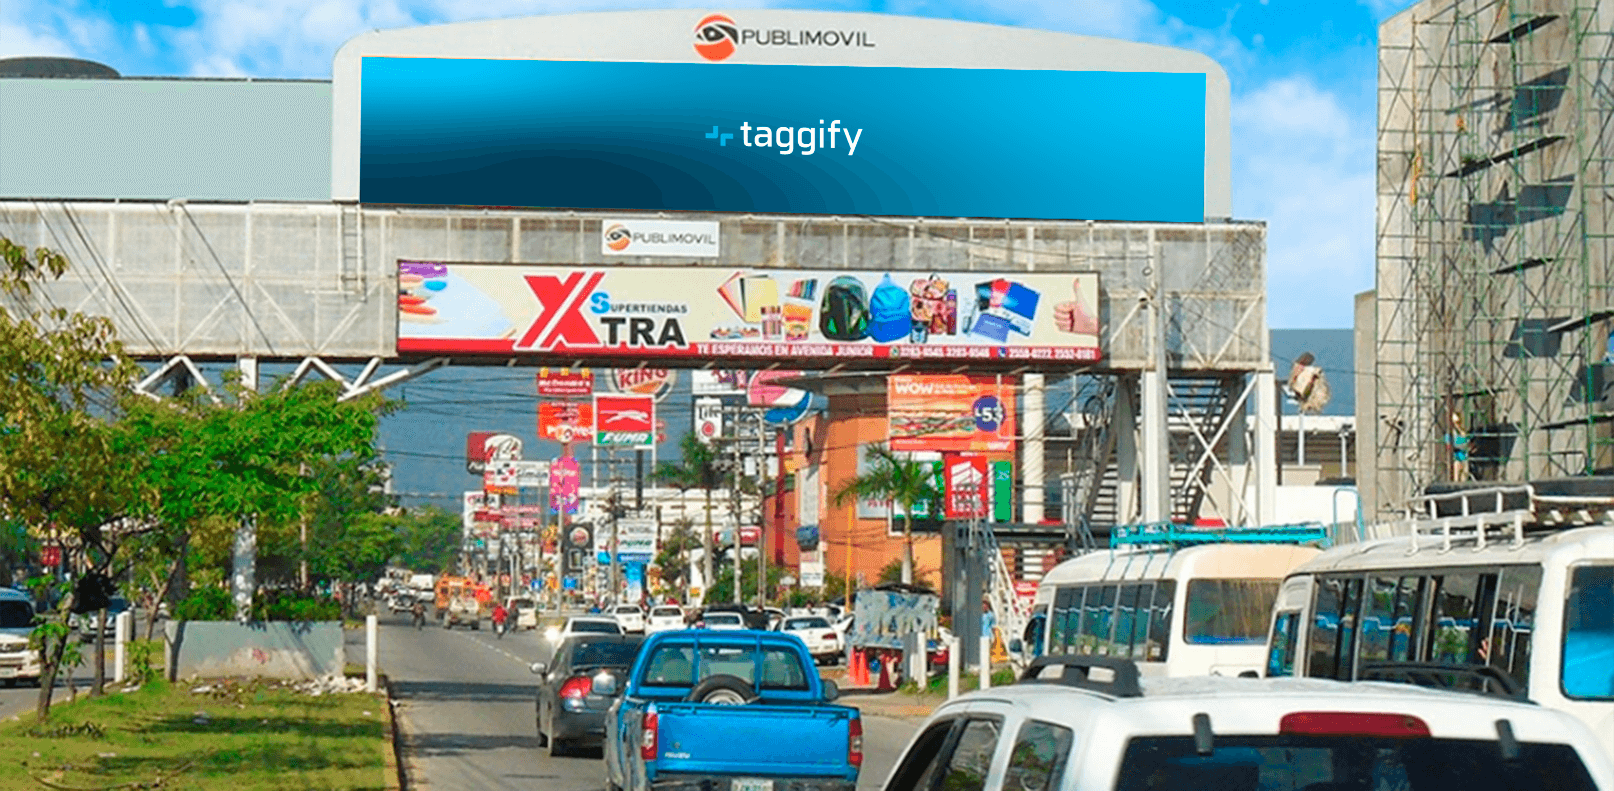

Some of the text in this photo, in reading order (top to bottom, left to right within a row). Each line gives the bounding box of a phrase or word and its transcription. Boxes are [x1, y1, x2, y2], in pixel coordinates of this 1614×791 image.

[741, 29, 875, 48] PUBLIMOVIL
[740, 119, 863, 156] taggify
[633, 231, 717, 245] PUBLIMOVIL
[590, 292, 688, 315] SUPERTIENDAS
[697, 343, 873, 357] TE ESPERAMOS EN AVENIDA JUNIOR
[619, 367, 669, 388] KING
[895, 382, 933, 394] WOW
